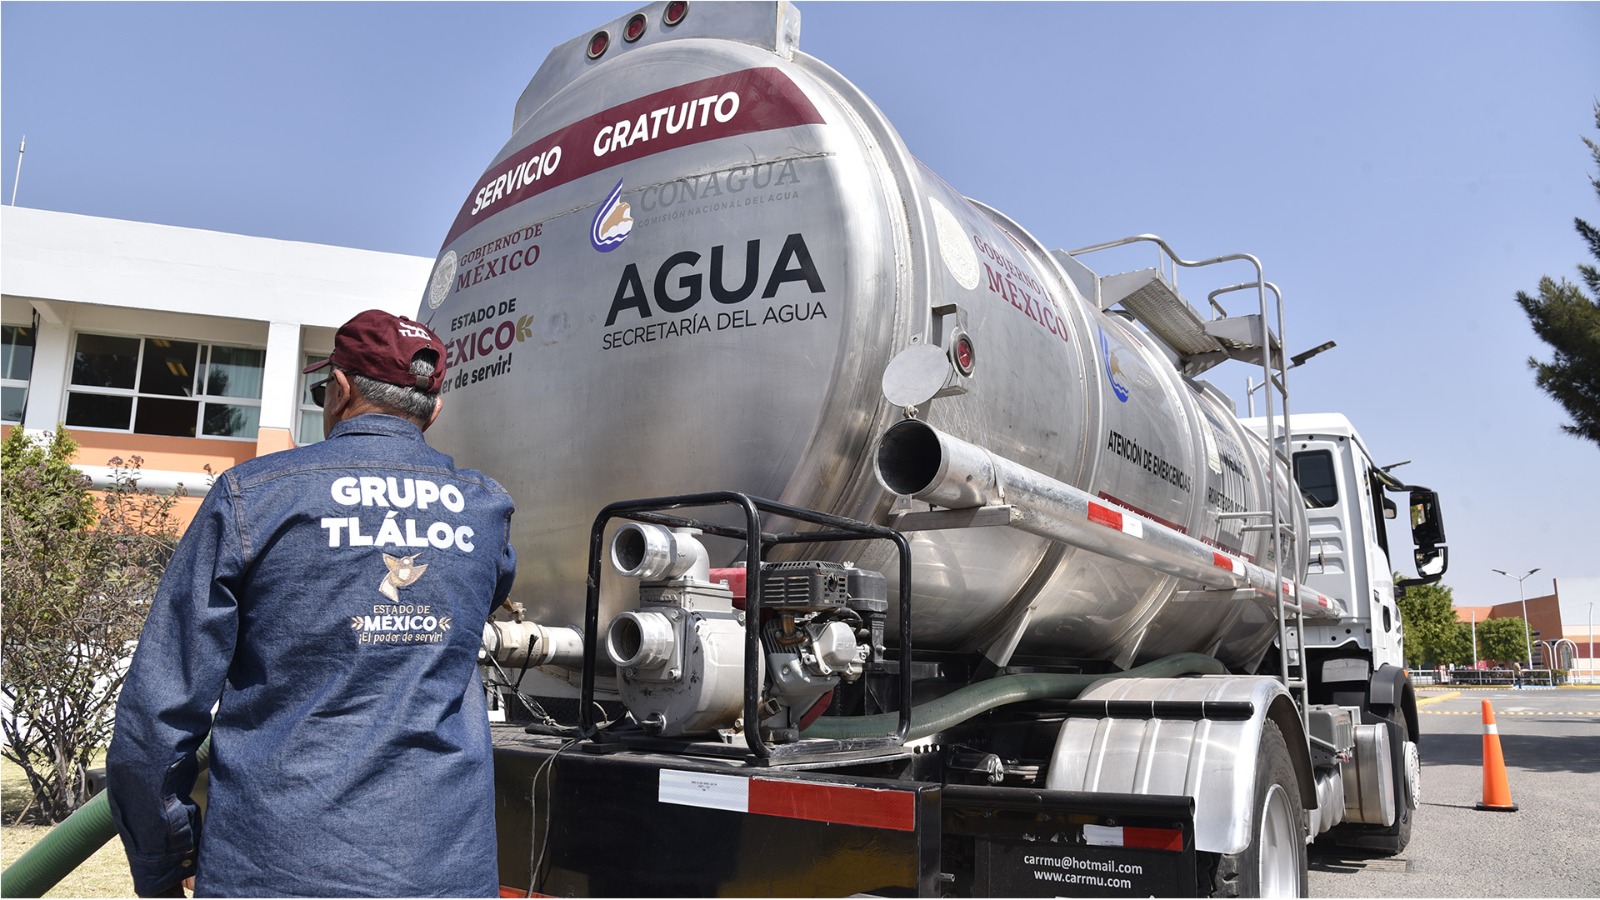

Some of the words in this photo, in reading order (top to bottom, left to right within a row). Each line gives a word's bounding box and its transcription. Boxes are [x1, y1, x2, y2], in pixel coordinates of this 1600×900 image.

[471, 145, 562, 216] SERVICIO
[593, 91, 740, 157] GRATUITO
[639, 160, 800, 212] CONAGUA
[638, 210, 685, 228] COMISIÓN
[688, 200, 742, 215] NACIONAL
[744, 196, 763, 207] DEL
[767, 190, 800, 202] AGUA
[460, 231, 520, 267] GOBIERNO
[524, 223, 543, 241] DE
[973, 235, 1041, 295] GOBIERNO
[455, 245, 540, 293] MÉXICO
[604, 233, 826, 327] AGUA
[451, 305, 496, 332] ESTADO
[498, 298, 516, 316] DE
[983, 262, 1068, 343] MÉXICO
[446, 320, 515, 369] ÉXICO
[602, 313, 711, 350] SECRETARÍA
[717, 310, 756, 331] DEL
[762, 301, 827, 325] AGUA
[454, 368, 468, 390] de
[471, 352, 512, 385] servir!
[1107, 430, 1142, 467] ATENCIÓN
[1143, 449, 1152, 472] DE
[1153, 454, 1191, 494] EMERGENCIAS
[331, 476, 465, 513] GRUPO
[321, 511, 475, 553] TLÁLOC
[363, 614, 438, 632] MÉXICO
[373, 604, 414, 614] ESTADO
[417, 605, 431, 614] DE
[358, 632, 371, 645] ¡El
[373, 632, 400, 645] poder
[402, 632, 413, 642] de
[415, 631, 443, 643] servir!
[1024, 854, 1143, 875] carrmu@hotmail.com
[1034, 870, 1132, 889] www.carrmu.com
